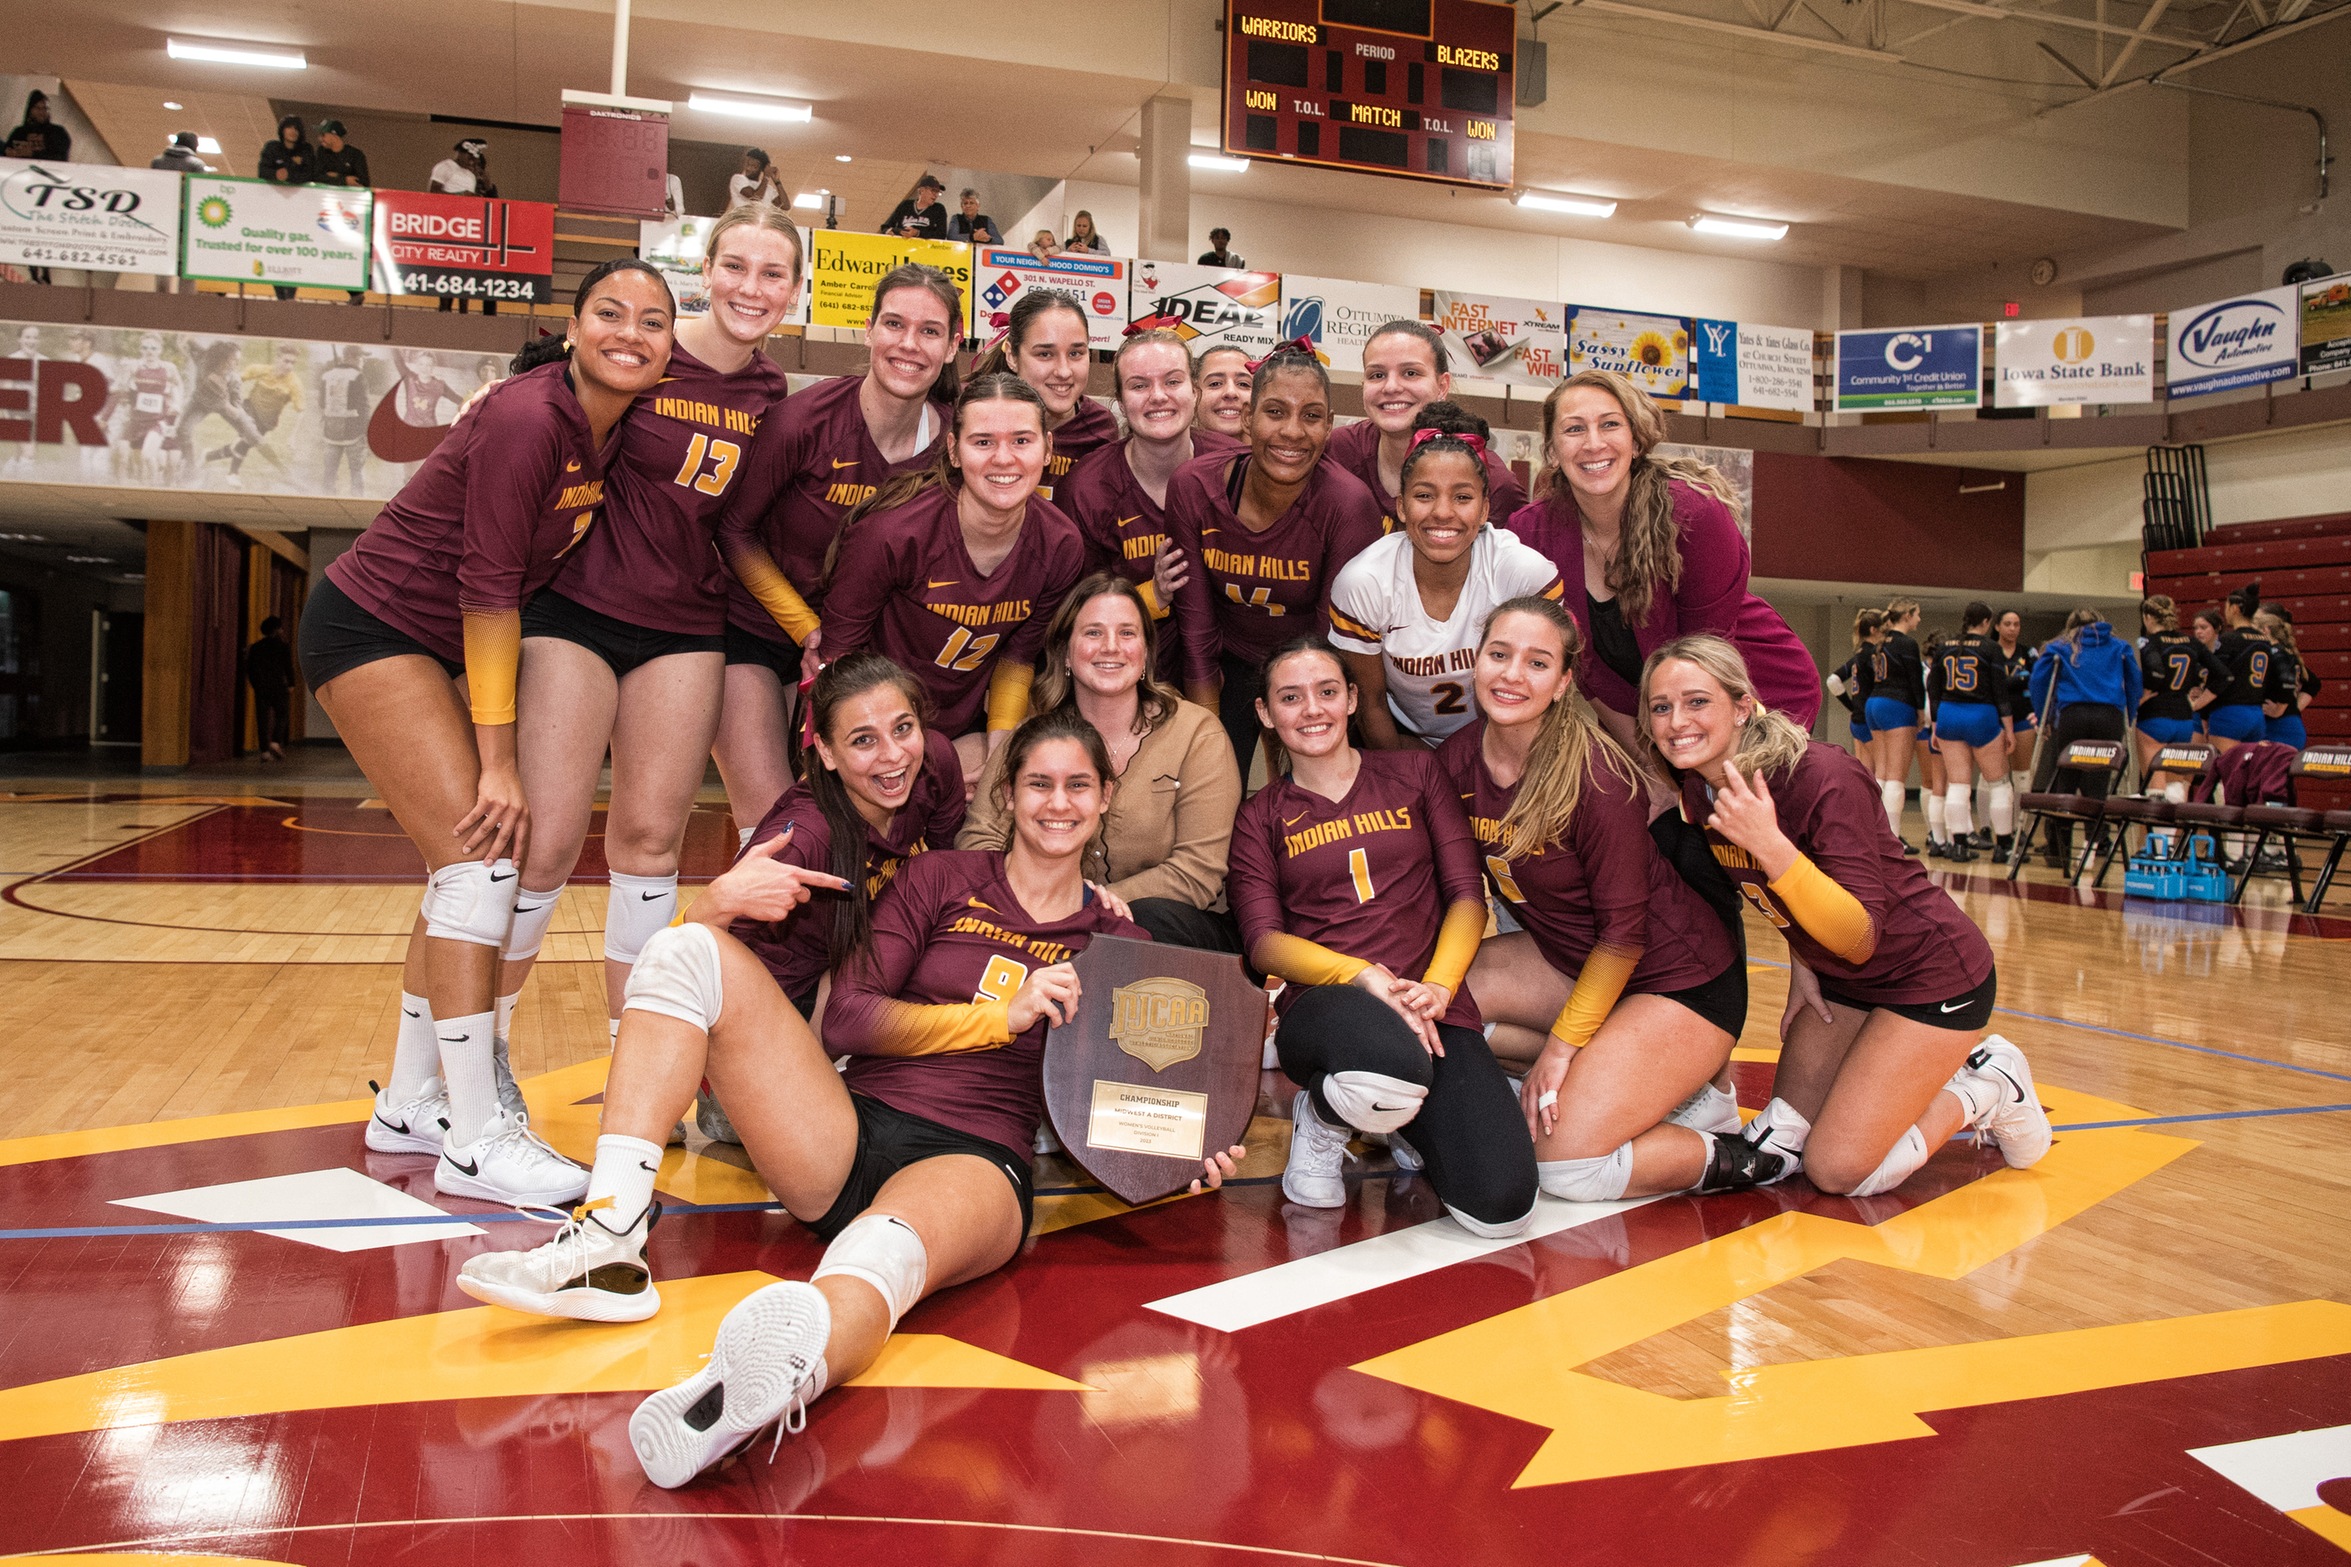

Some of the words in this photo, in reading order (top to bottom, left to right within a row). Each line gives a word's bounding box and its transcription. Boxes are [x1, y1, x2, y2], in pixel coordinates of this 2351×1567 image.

[1242, 16, 1317, 43] WARRIORS
[1356, 43, 1395, 60] PERIOD
[1438, 46, 1498, 71] BLAZERS
[1246, 90, 1276, 111] WON
[1294, 100, 1325, 116] T.O.L.
[1352, 104, 1401, 127] MATCH
[1424, 118, 1453, 133] T.O.L.
[1467, 120, 1496, 140] WON
[25, 183, 142, 213] TSD
[220, 184, 236, 195] bp
[241, 227, 286, 241] Quality
[288, 232, 313, 243] gas.
[391, 213, 481, 239] BRIDGE
[22, 247, 137, 266] 641.682.4561
[196, 239, 242, 251] Trusted
[245, 243, 263, 253] for
[266, 246, 293, 256] over
[297, 246, 318, 257] 100
[321, 251, 357, 261] years.
[391, 245, 424, 260] CITY
[427, 248, 480, 263] REALTY
[816, 248, 897, 275] Edward
[995, 256, 1015, 264] YOUR
[1074, 263, 1111, 274] DOMINO'S
[398, 272, 535, 300] 41-684-1234
[820, 280, 847, 289] Amber
[1049, 277, 1084, 287] WAPELLO
[1085, 280, 1096, 288] ST.
[820, 301, 839, 310] (641)
[1155, 297, 1264, 329] IDEAL
[1450, 302, 1489, 318] FAST
[1441, 315, 1518, 336] INTERNET
[2193, 315, 2277, 353] Vaughn
[1089, 336, 1110, 344] xpert!
[1224, 333, 1254, 344] READY
[1257, 335, 1275, 345] MIX
[1575, 340, 1629, 358] Sassy
[1514, 347, 1551, 362] FAST
[2214, 344, 2273, 364] Automotive
[1526, 362, 1560, 378] WIFI
[1589, 356, 1684, 377] Sunflower
[2003, 367, 2045, 381] Iowa
[2051, 364, 2095, 379] State
[2100, 361, 2146, 377] Bank
[1850, 374, 1900, 386] Community
[1914, 372, 1939, 382] Credit
[1940, 371, 1967, 382] Union
[2172, 365, 2291, 396] www.vaughnautomotive.com
[655, 398, 721, 427] INDIAN
[674, 432, 741, 497] 13
[825, 484, 877, 506] INDIA
[1123, 533, 1166, 560] INDIA
[1201, 548, 1255, 576] NDIAN
[1259, 555, 1310, 581] HILLS
[926, 602, 990, 626] INDIAN
[992, 600, 1031, 624] HILLS
[934, 625, 1000, 671] 12
[1389, 654, 1446, 677] NDIAN
[1943, 655, 1979, 691] 15
[2169, 654, 2191, 690] 7
[2249, 651, 2269, 687] 9
[1430, 681, 1468, 715] 2
[2069, 744, 2096, 757] INDIAN
[2096, 746, 2117, 758] HILLS
[2161, 748, 2187, 760] INDIAN
[2188, 749, 2209, 762] HILLS
[2302, 751, 2334, 765] INDIAN
[1284, 818, 1353, 859] INDIAN
[1353, 806, 1412, 835] HILLS
[1349, 847, 1375, 904] 1
[1114, 993, 1206, 1034] NJCAA
[1120, 1093, 1180, 1108] CHAMPIONSHIP
[1119, 1121, 1143, 1129] WOMEN'S
[1145, 1124, 1175, 1133] VOLLEYBALL
[1153, 1112, 1182, 1121] DISTRICT
